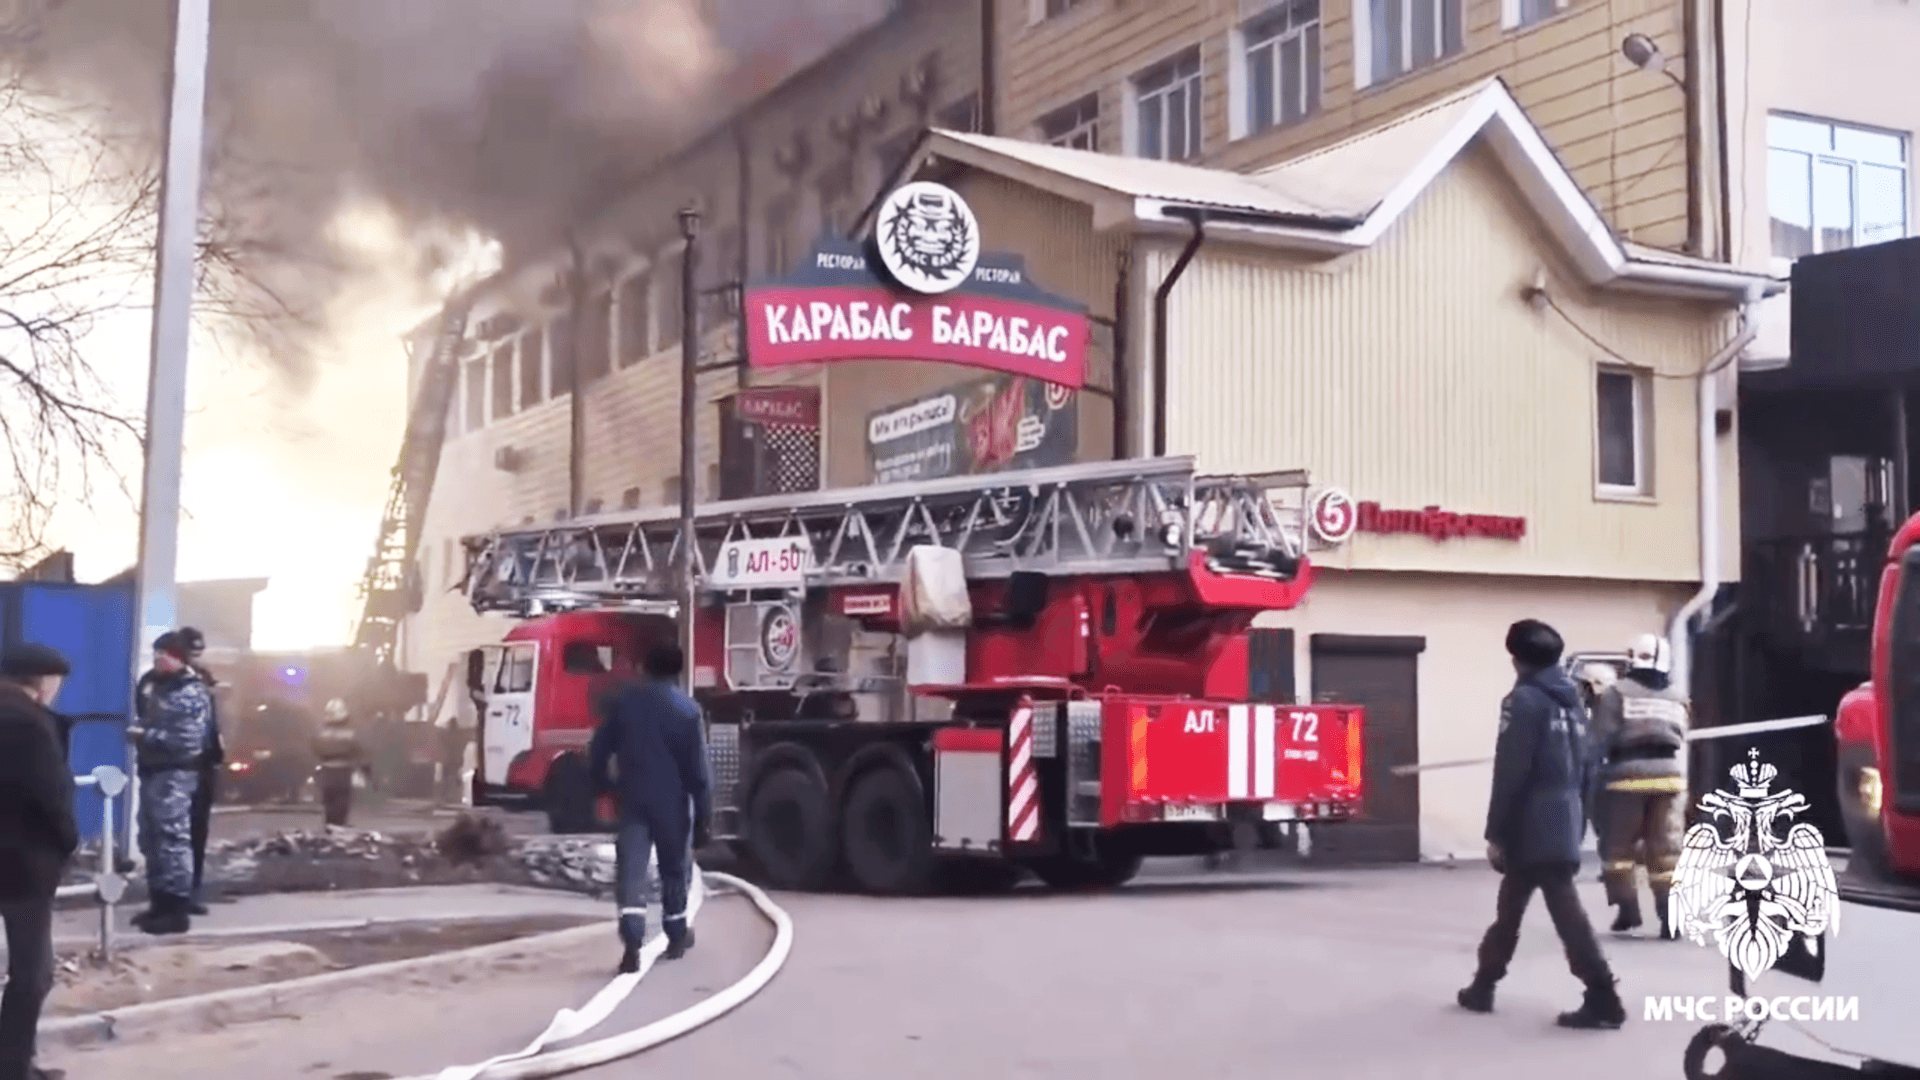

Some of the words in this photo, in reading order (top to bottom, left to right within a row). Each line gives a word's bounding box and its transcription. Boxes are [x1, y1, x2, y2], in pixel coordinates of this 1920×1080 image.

[816, 252, 866, 270] РЕСТОРАН
[975, 266, 1022, 284] РЕСТОРАН
[764, 301, 913, 344] КАРАБАС
[932, 305, 1069, 362] БАРАБАС
[1325, 493, 1345, 532] 5
[747, 548, 800, 573] АЛ-50
[506, 704, 520, 727] 72
[1290, 711, 1319, 742] 72
